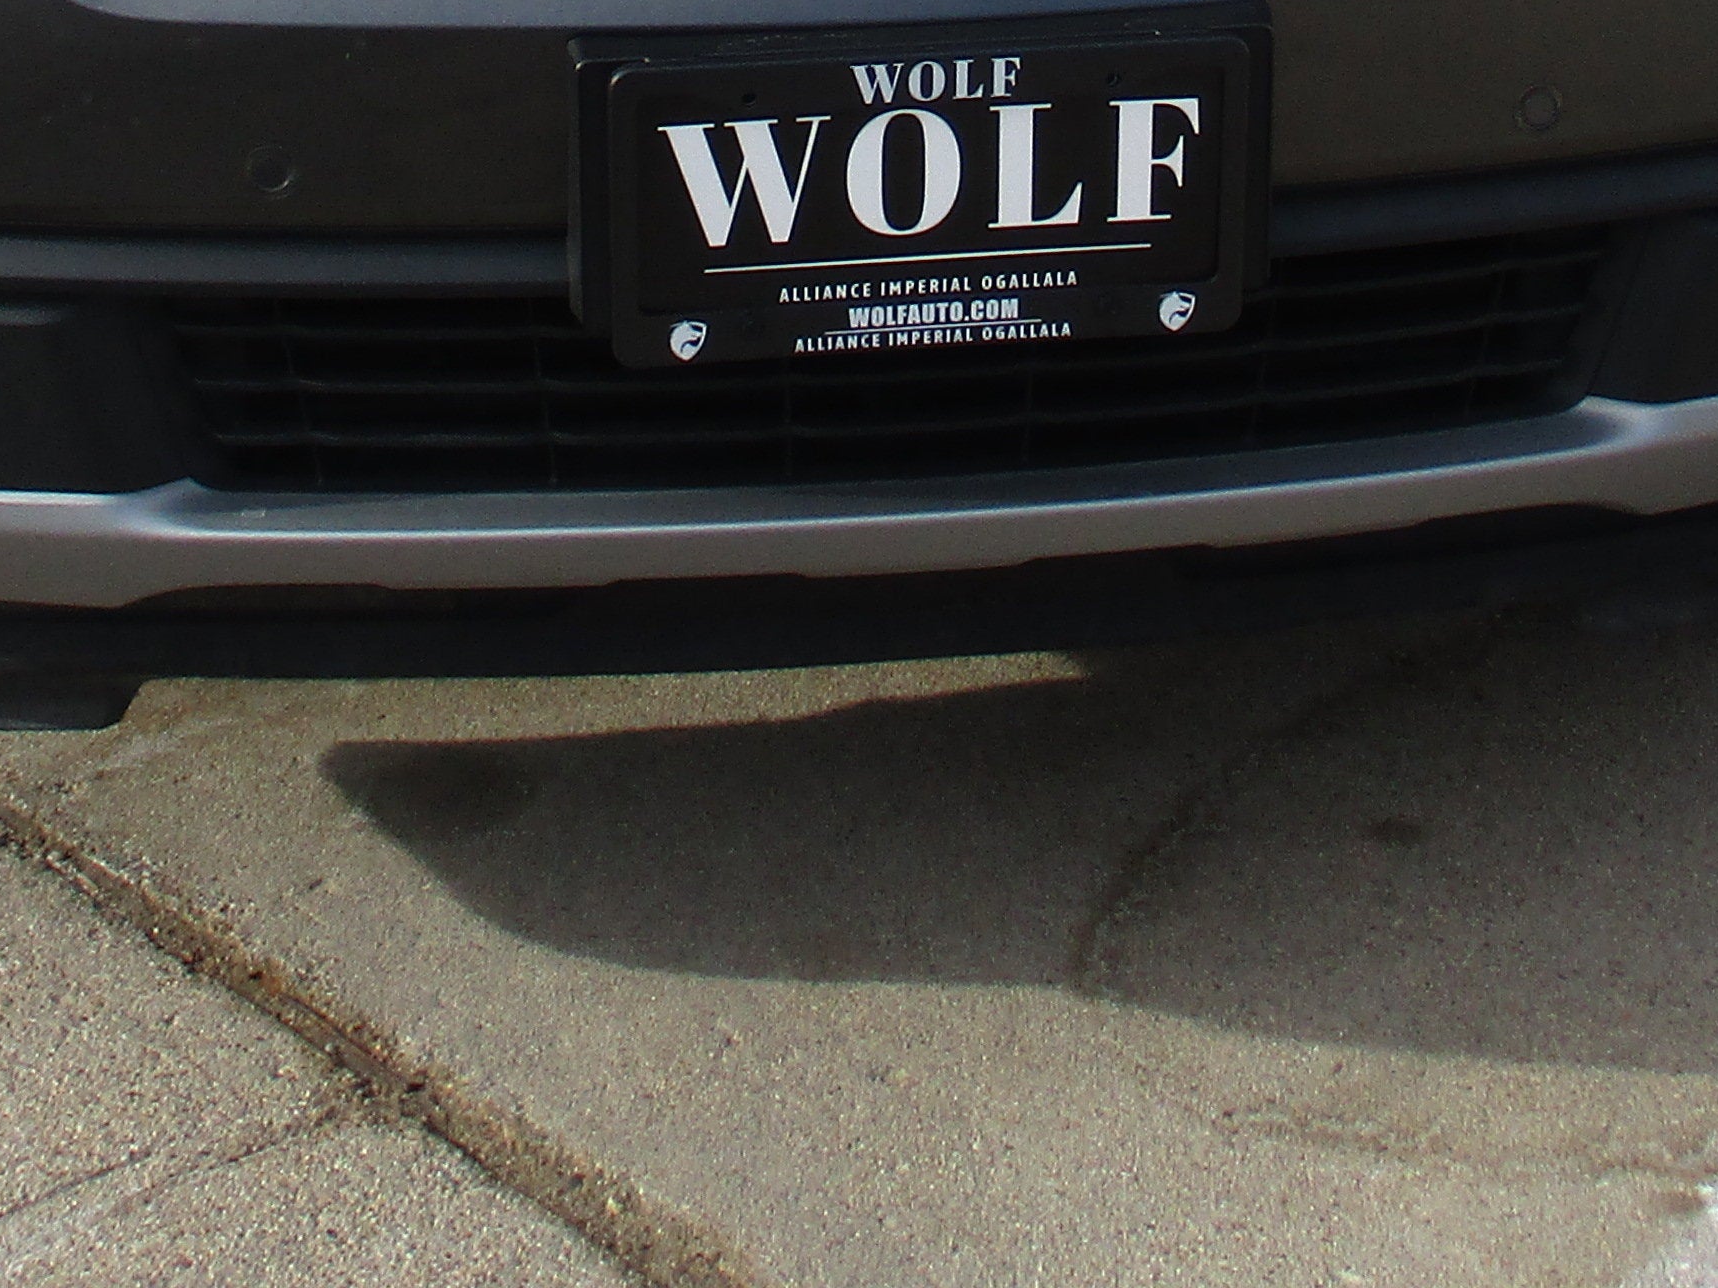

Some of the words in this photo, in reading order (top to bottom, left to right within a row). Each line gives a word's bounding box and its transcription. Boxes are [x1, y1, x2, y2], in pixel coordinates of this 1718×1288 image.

[850, 56, 1023, 105] WOLF
[657, 97, 1202, 248] WOLF
[779, 281, 873, 303] ALLIANCE
[879, 275, 973, 296] IMPERIAL
[981, 270, 1078, 291] OGALLALA
[848, 298, 1020, 329] WOLFAUTO.COM
[794, 333, 881, 353] ALLIANCE
[885, 328, 974, 347] IMPERIAL
[981, 322, 1072, 342] OGALLALA
